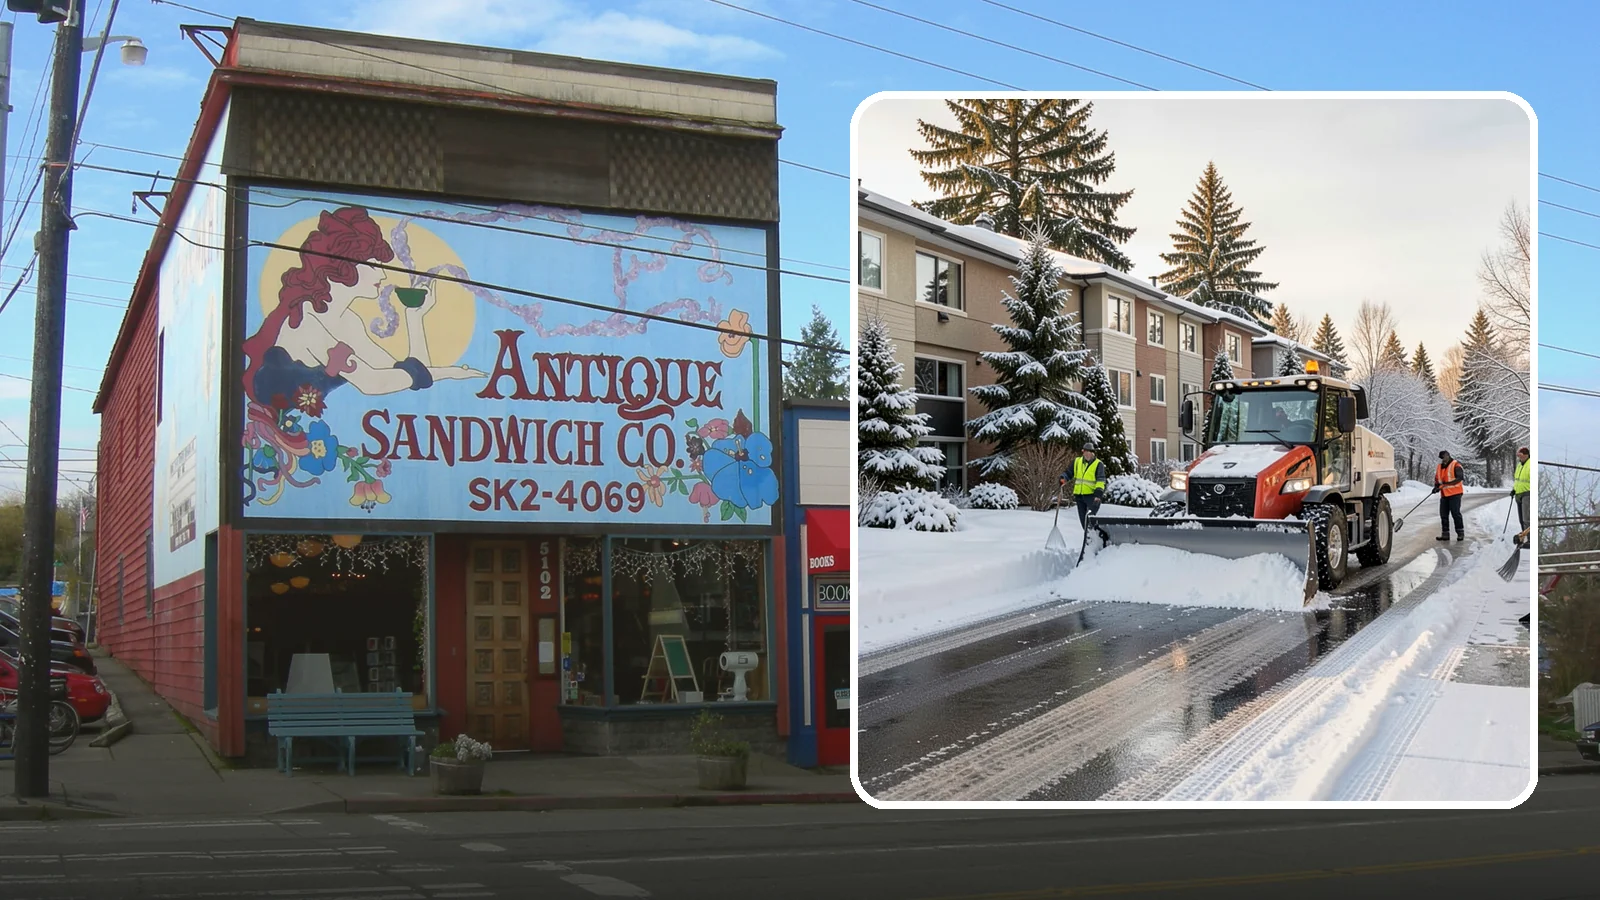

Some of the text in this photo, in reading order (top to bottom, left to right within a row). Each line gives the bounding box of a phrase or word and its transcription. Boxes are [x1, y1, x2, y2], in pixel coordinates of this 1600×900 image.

[475, 329, 723, 420] ANTIQUE
[361, 409, 685, 469] SANDWICH CO.
[468, 478, 646, 513] SK2-4069
[540, 542, 551, 599] 5102
[809, 555, 835, 569] BOOKS
